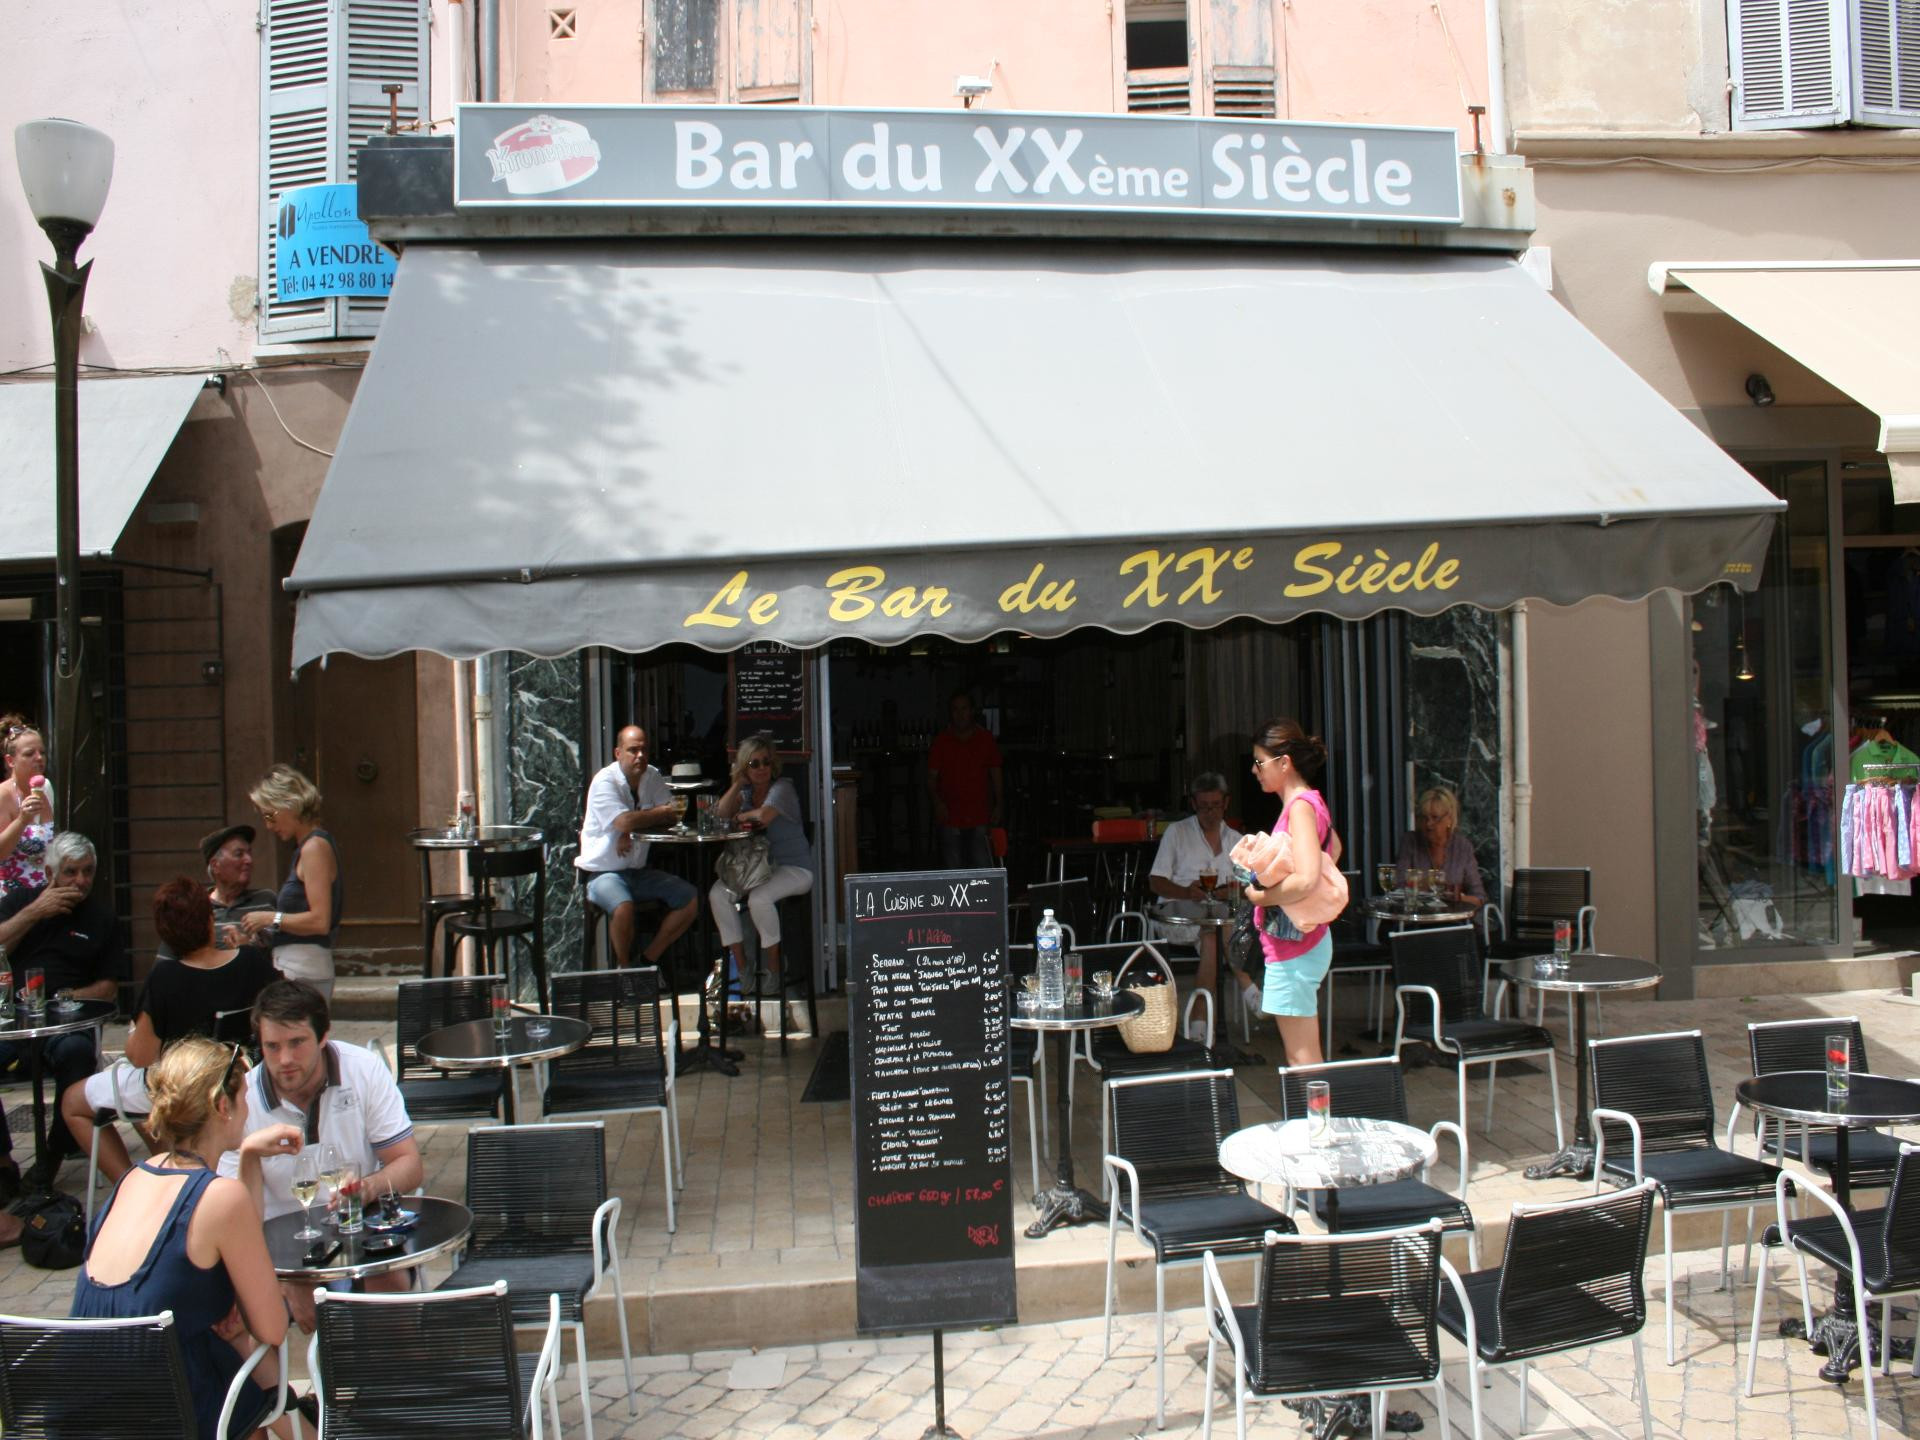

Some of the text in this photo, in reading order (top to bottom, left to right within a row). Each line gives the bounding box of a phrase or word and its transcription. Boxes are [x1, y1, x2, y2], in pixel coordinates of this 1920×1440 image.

[675, 121, 1413, 206] Bar du XXème Siècle
[290, 245, 384, 270] A VENDRE
[282, 273, 393, 294] Tél: 04 42 98 80 14
[683, 542, 1460, 628] Le Bar du XXe Siècle
[855, 889, 874, 917] LA
[931, 895, 944, 906] DU
[871, 971, 888, 982] PATA
[892, 972, 911, 980] NEGRA
[871, 984, 888, 996] PATA
[894, 984, 913, 992] NEGRA
[873, 1000, 888, 1009] PAN
[873, 1012, 903, 1022] PATATAS
